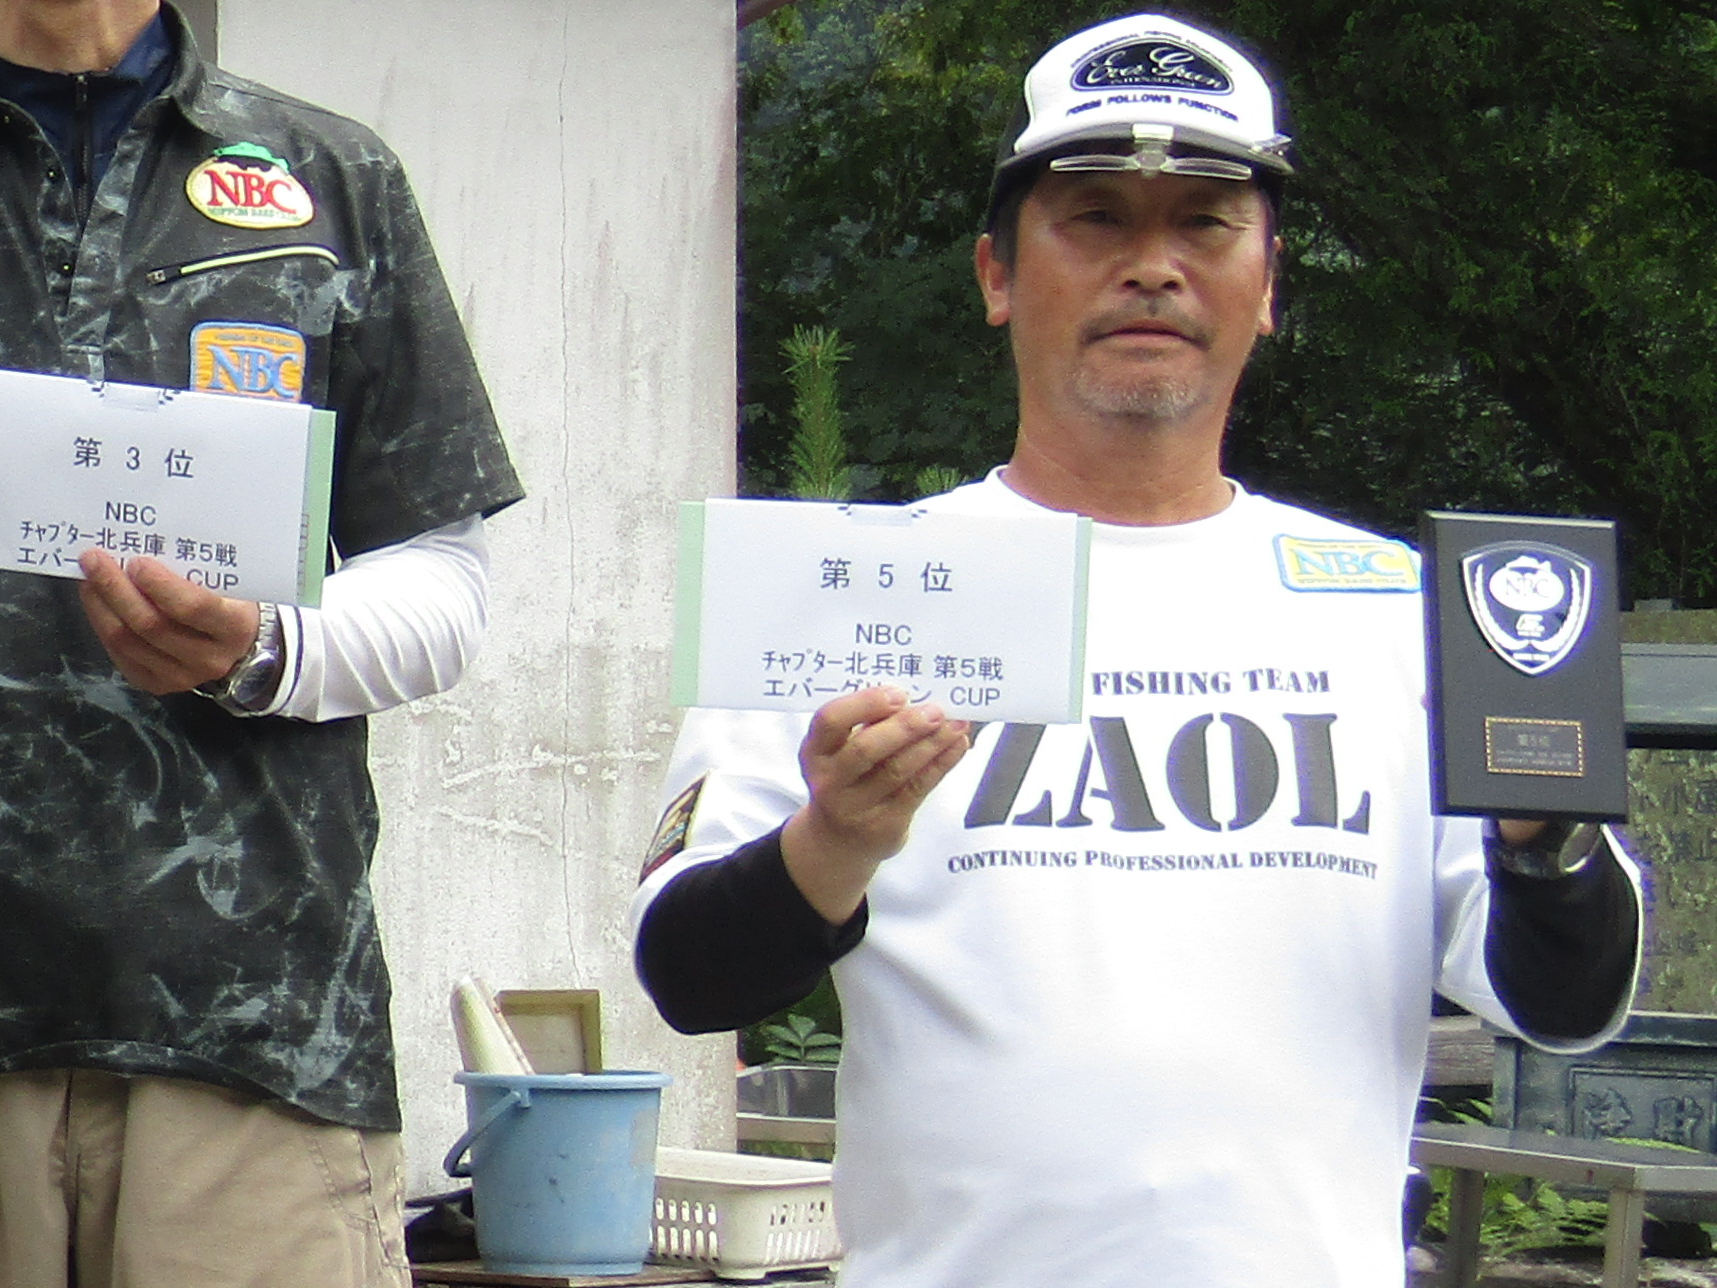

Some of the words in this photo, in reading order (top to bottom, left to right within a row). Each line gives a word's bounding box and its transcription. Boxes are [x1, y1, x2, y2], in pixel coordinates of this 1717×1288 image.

[1149, 47, 1222, 88] Green
[1107, 94, 1173, 105] FOLLOWS
[203, 169, 298, 215] NBC
[206, 344, 300, 399] NBC
[105, 500, 157, 527] NBC
[175, 537, 238, 568] 第5戦
[1288, 548, 1405, 577] NBC
[186, 568, 240, 592] CUP
[854, 623, 913, 646] NBC
[933, 655, 1005, 682] 第5戦
[1090, 670, 1233, 697] FISHING
[1242, 667, 1331, 694] TEAM
[949, 685, 1002, 707] CUP
[964, 712, 1372, 836] ZAOL
[947, 849, 1078, 874] CONTINUING
[1084, 849, 1244, 872] PROFESSIONAL
[1249, 850, 1378, 881] DEVELOPMENT
